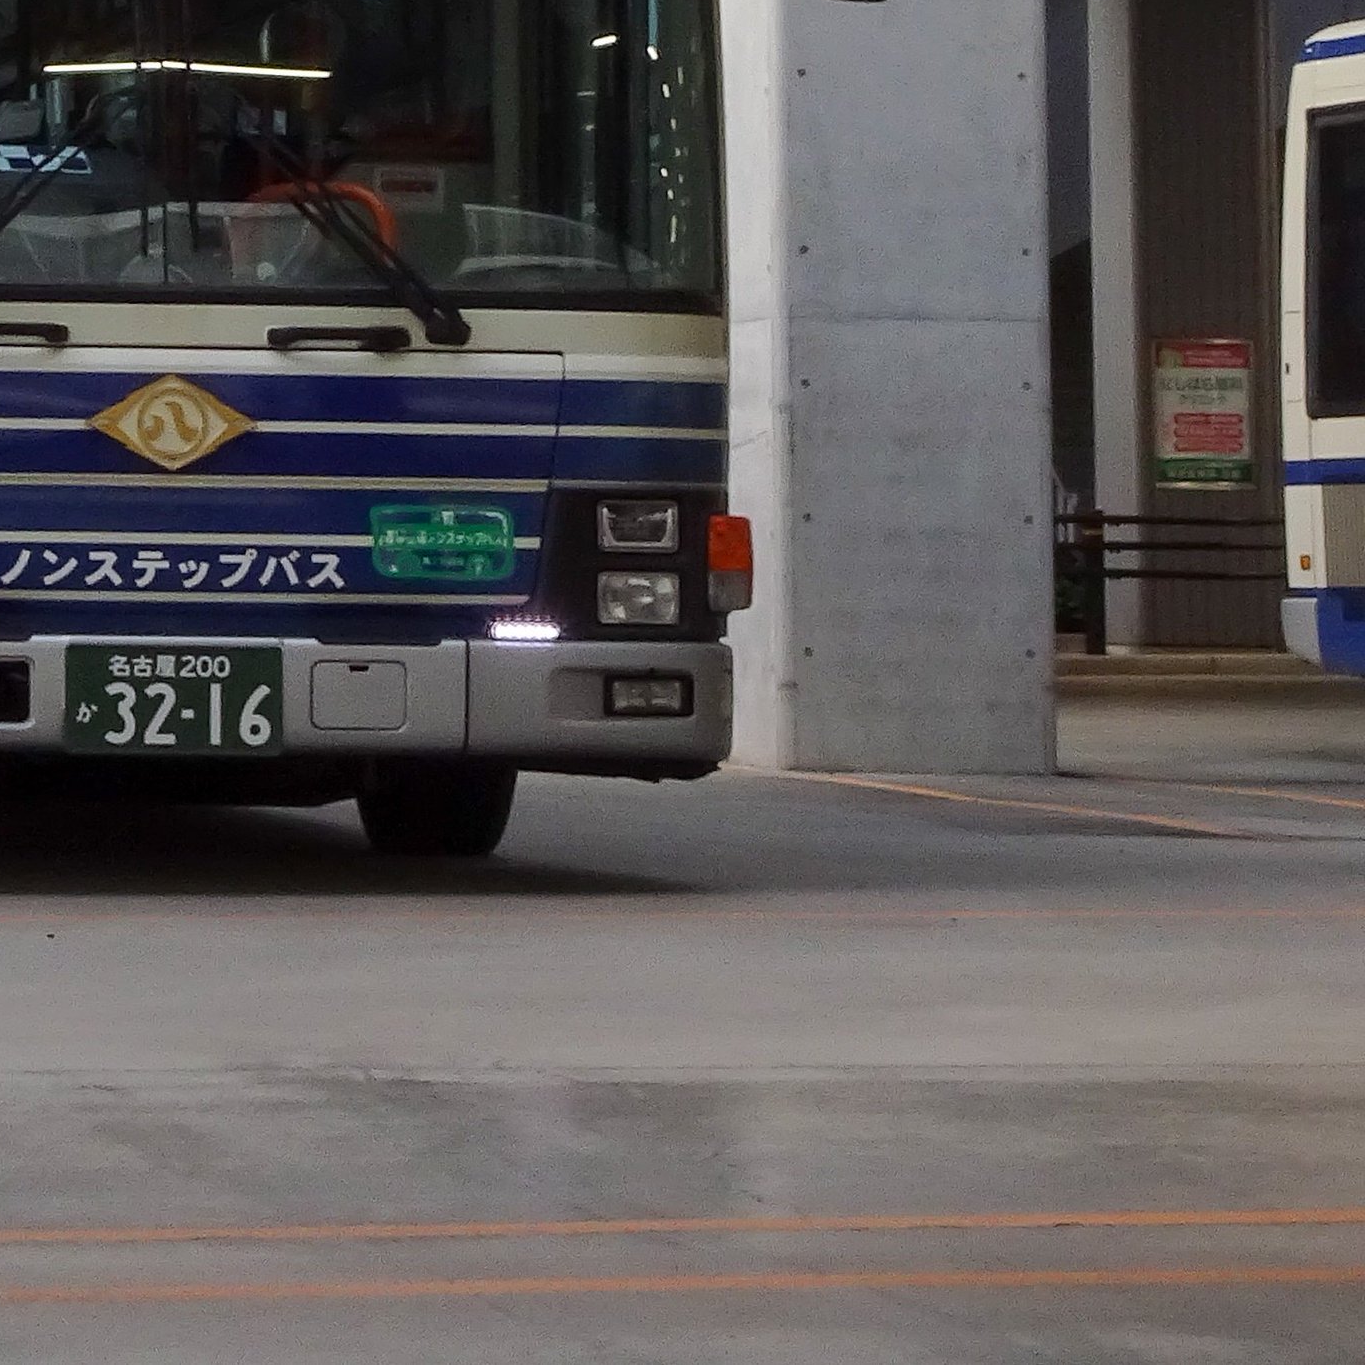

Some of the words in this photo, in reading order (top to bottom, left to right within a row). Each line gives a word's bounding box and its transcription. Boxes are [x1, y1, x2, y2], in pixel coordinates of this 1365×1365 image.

[0, 547, 345, 589] ノンステップバス
[104, 681, 273, 747] 32-16
